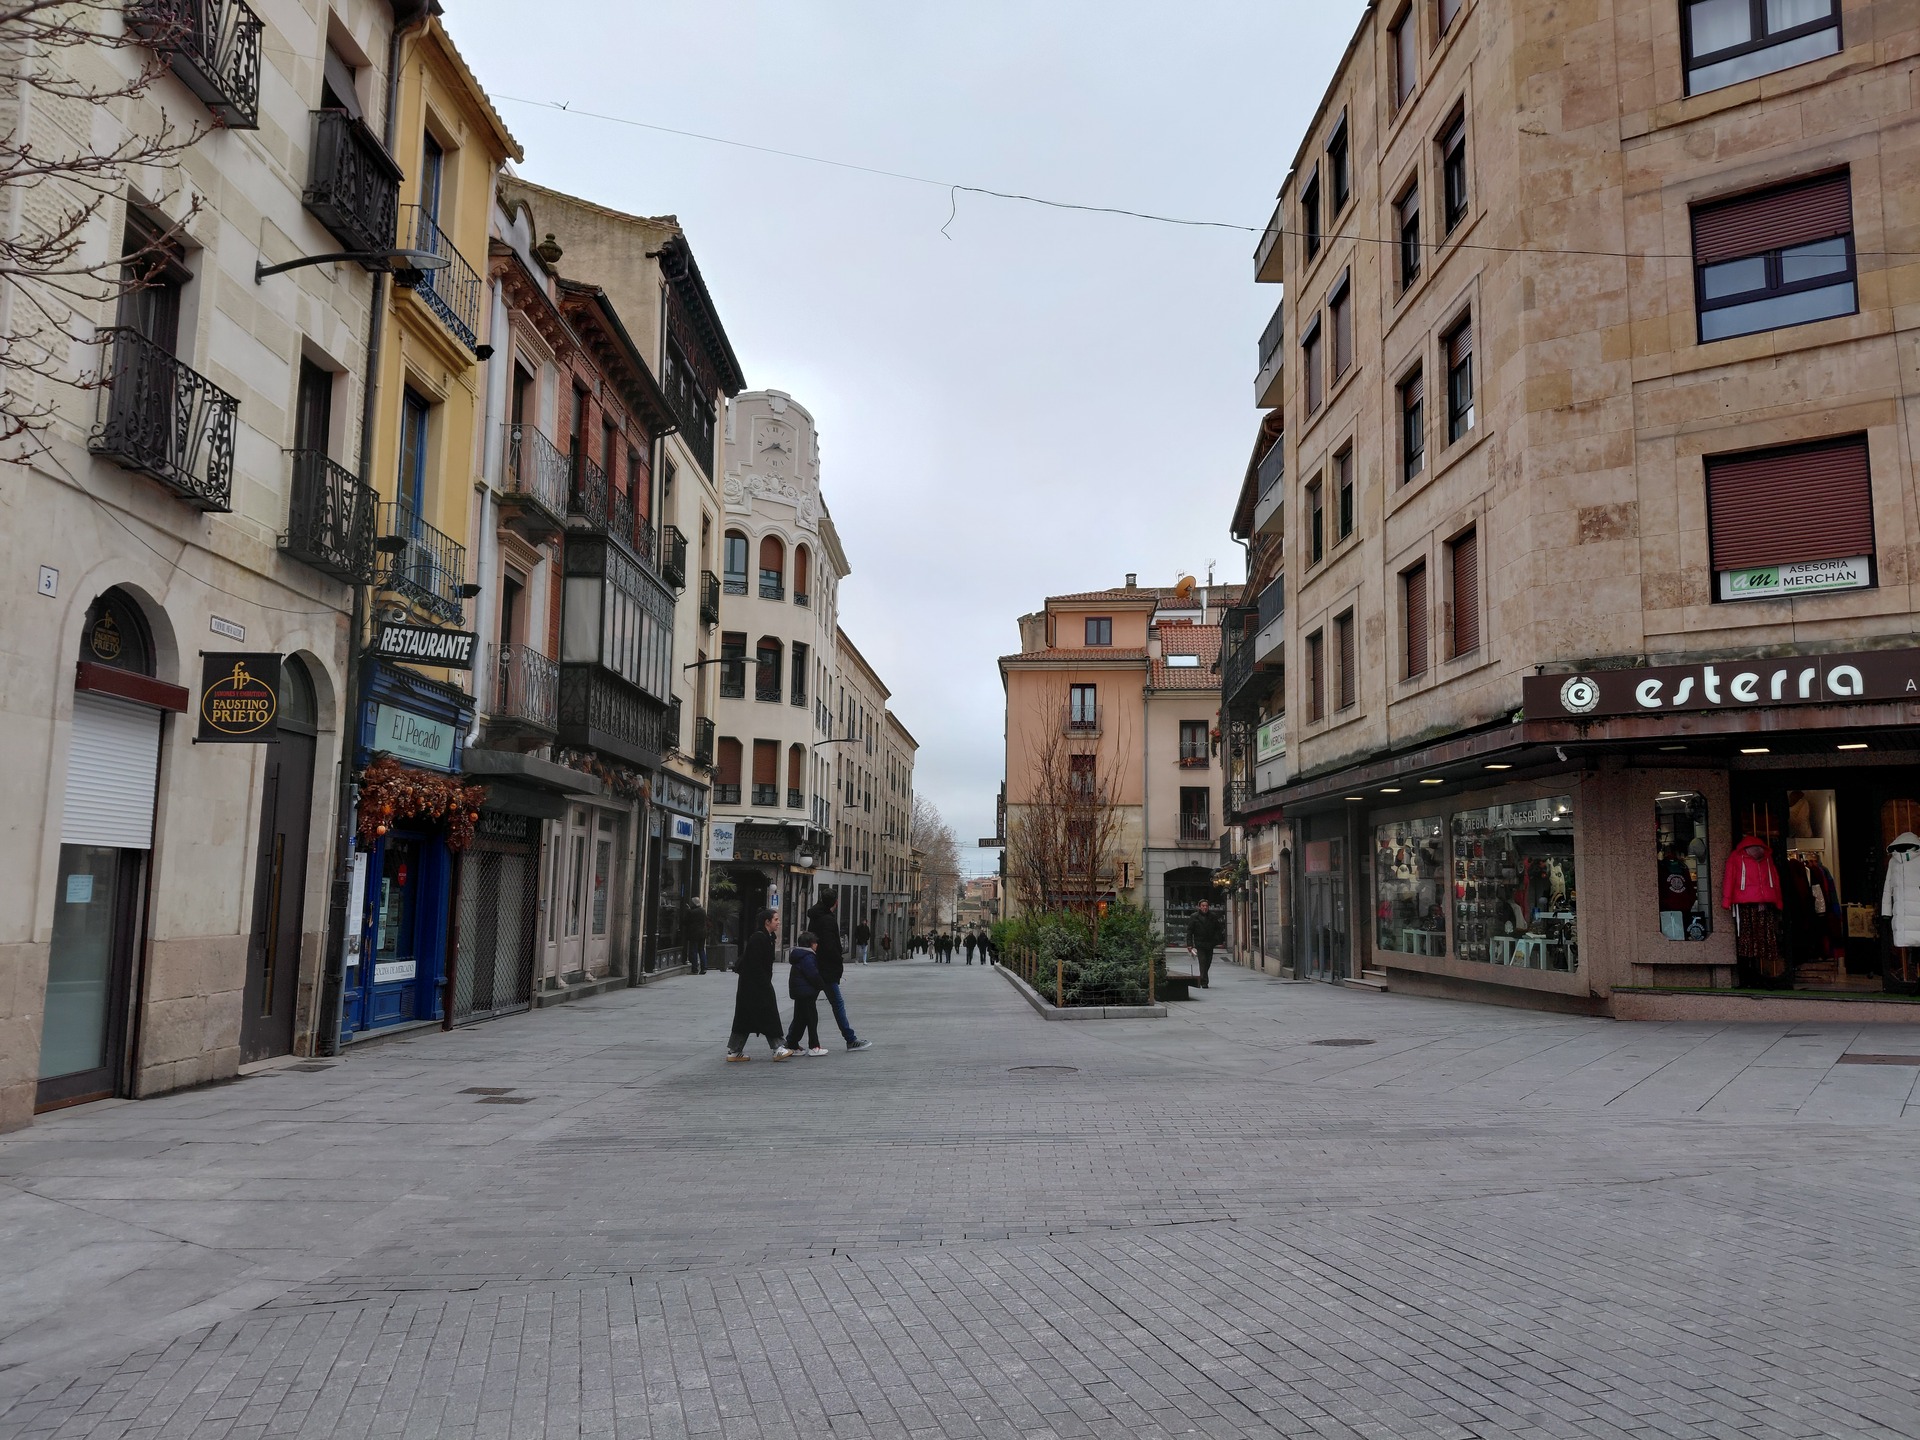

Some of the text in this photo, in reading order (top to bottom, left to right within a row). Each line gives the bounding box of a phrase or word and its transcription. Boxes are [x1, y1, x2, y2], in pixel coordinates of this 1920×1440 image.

[1789, 559, 1849, 574] ASESORÍA
[45, 575, 52, 590] 5
[1783, 570, 1857, 587] MERCHÁN
[380, 627, 472, 661] RESTAURANTE
[1635, 665, 1864, 708] esterra
[213, 699, 269, 710] FAUSTINO
[211, 709, 269, 723] PRIETO
[391, 714, 405, 741] El
[405, 717, 441, 751] Pecado
[753, 849, 785, 861] Paca
